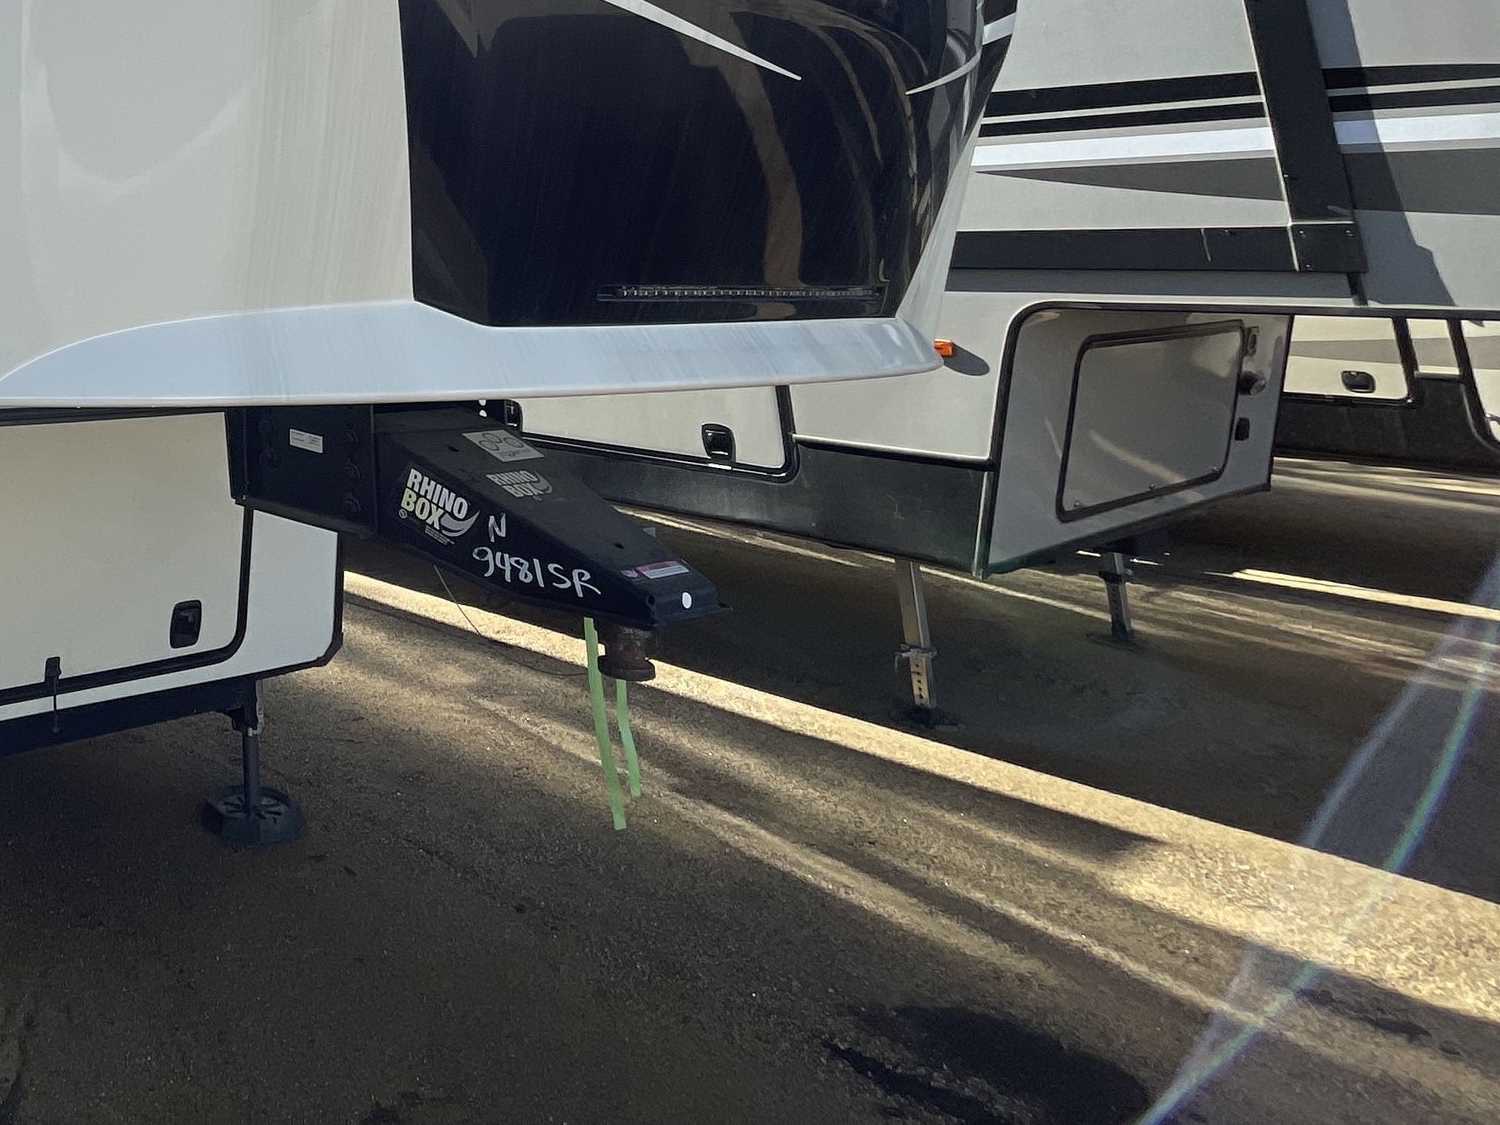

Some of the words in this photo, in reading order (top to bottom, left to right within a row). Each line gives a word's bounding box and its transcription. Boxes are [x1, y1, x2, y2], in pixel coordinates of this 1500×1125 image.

[406, 468, 469, 520] RHINO
[485, 470, 539, 486] RHINO
[501, 482, 544, 498] BOX
[400, 487, 445, 530] BOX
[488, 513, 506, 543] N
[472, 546, 602, 598] 9481SR
